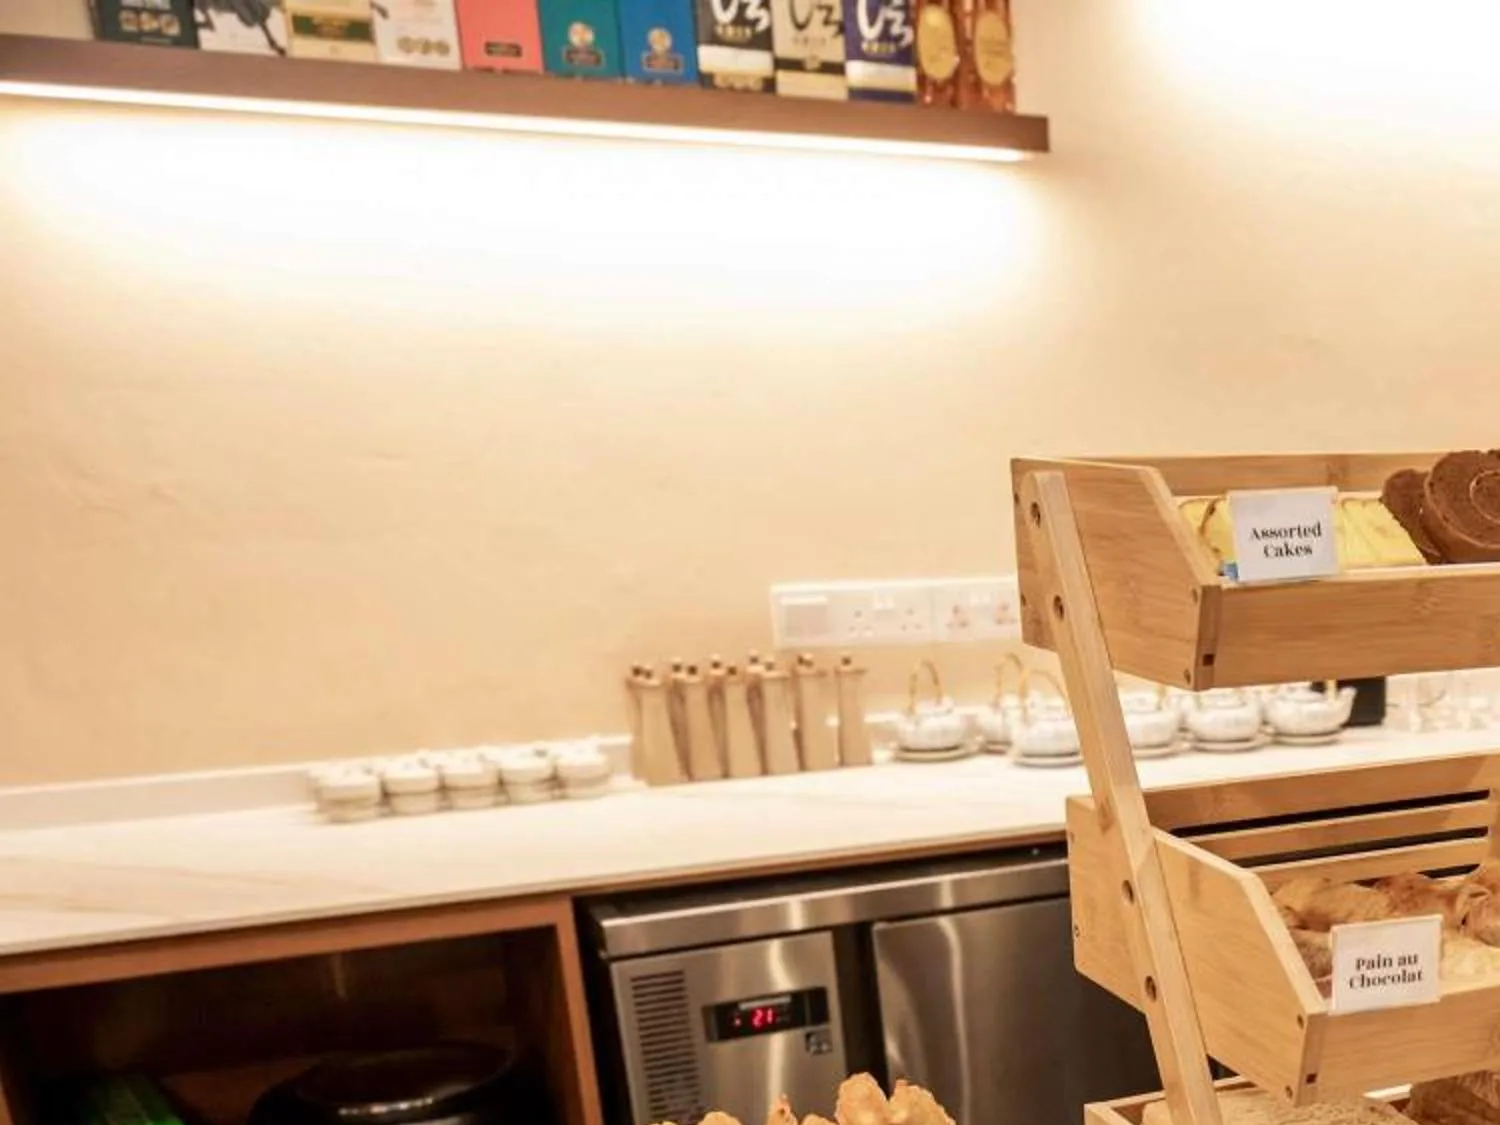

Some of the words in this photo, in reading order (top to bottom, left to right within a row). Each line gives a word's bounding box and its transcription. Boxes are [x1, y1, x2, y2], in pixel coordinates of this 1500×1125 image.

[1251, 521, 1322, 541] Assorted
[1263, 543, 1314, 559] Cakes
[1355, 953, 1393, 971] Pain
[1397, 953, 1419, 966] au
[1349, 969, 1423, 990] Chocolat
